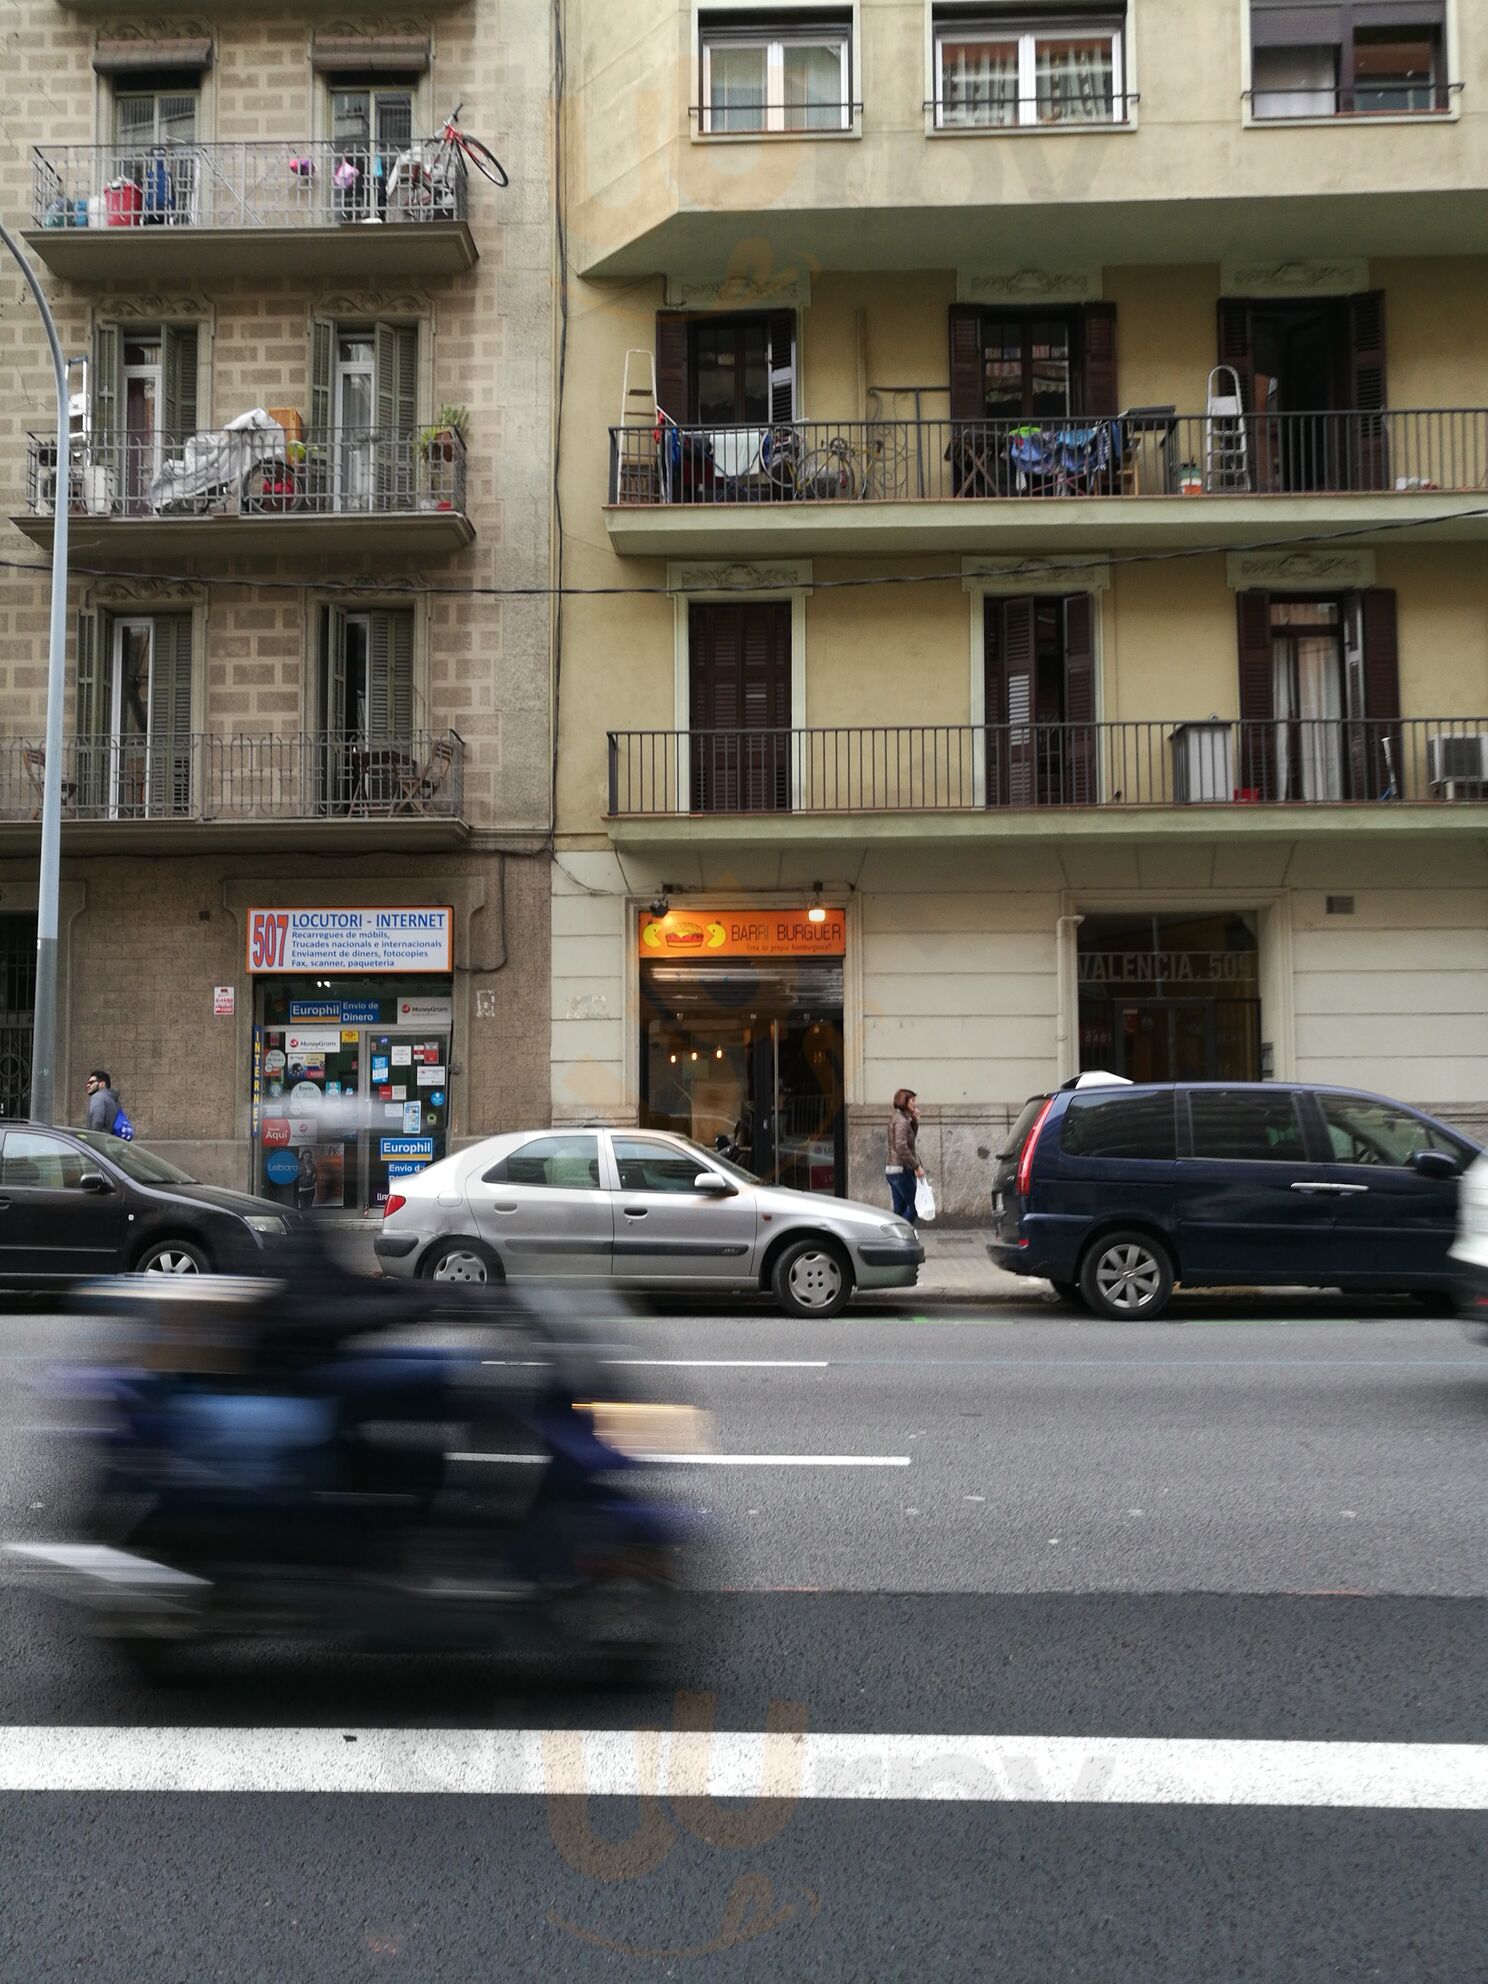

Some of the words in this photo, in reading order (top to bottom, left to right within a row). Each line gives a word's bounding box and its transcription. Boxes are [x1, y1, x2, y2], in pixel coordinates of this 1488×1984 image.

[292, 913, 362, 927] LOCUTORI
[376, 913, 445, 927] INTERNET
[292, 930, 344, 940] Recarregues
[346, 931, 357, 939] de
[777, 923, 841, 941] BURGUER
[252, 914, 289, 967] 507
[292, 940, 329, 948] Trucades
[331, 940, 372, 948] nacionals
[381, 940, 442, 948] internacionals
[291, 950, 337, 958] Enviament
[339, 950, 350, 958] de
[352, 950, 381, 959] diners,
[383, 949, 428, 959] fotocopies
[291, 960, 308, 968] Fax,
[348, 959, 395, 968] paqueteria
[292, 1004, 340, 1017] Europhil
[368, 1002, 379, 1010] de
[342, 1012, 374, 1021] Dinero
[300, 1040, 336, 1048] MoneyGram
[253, 1031, 261, 1133] INTERNET
[383, 1141, 431, 1155] Europhil
